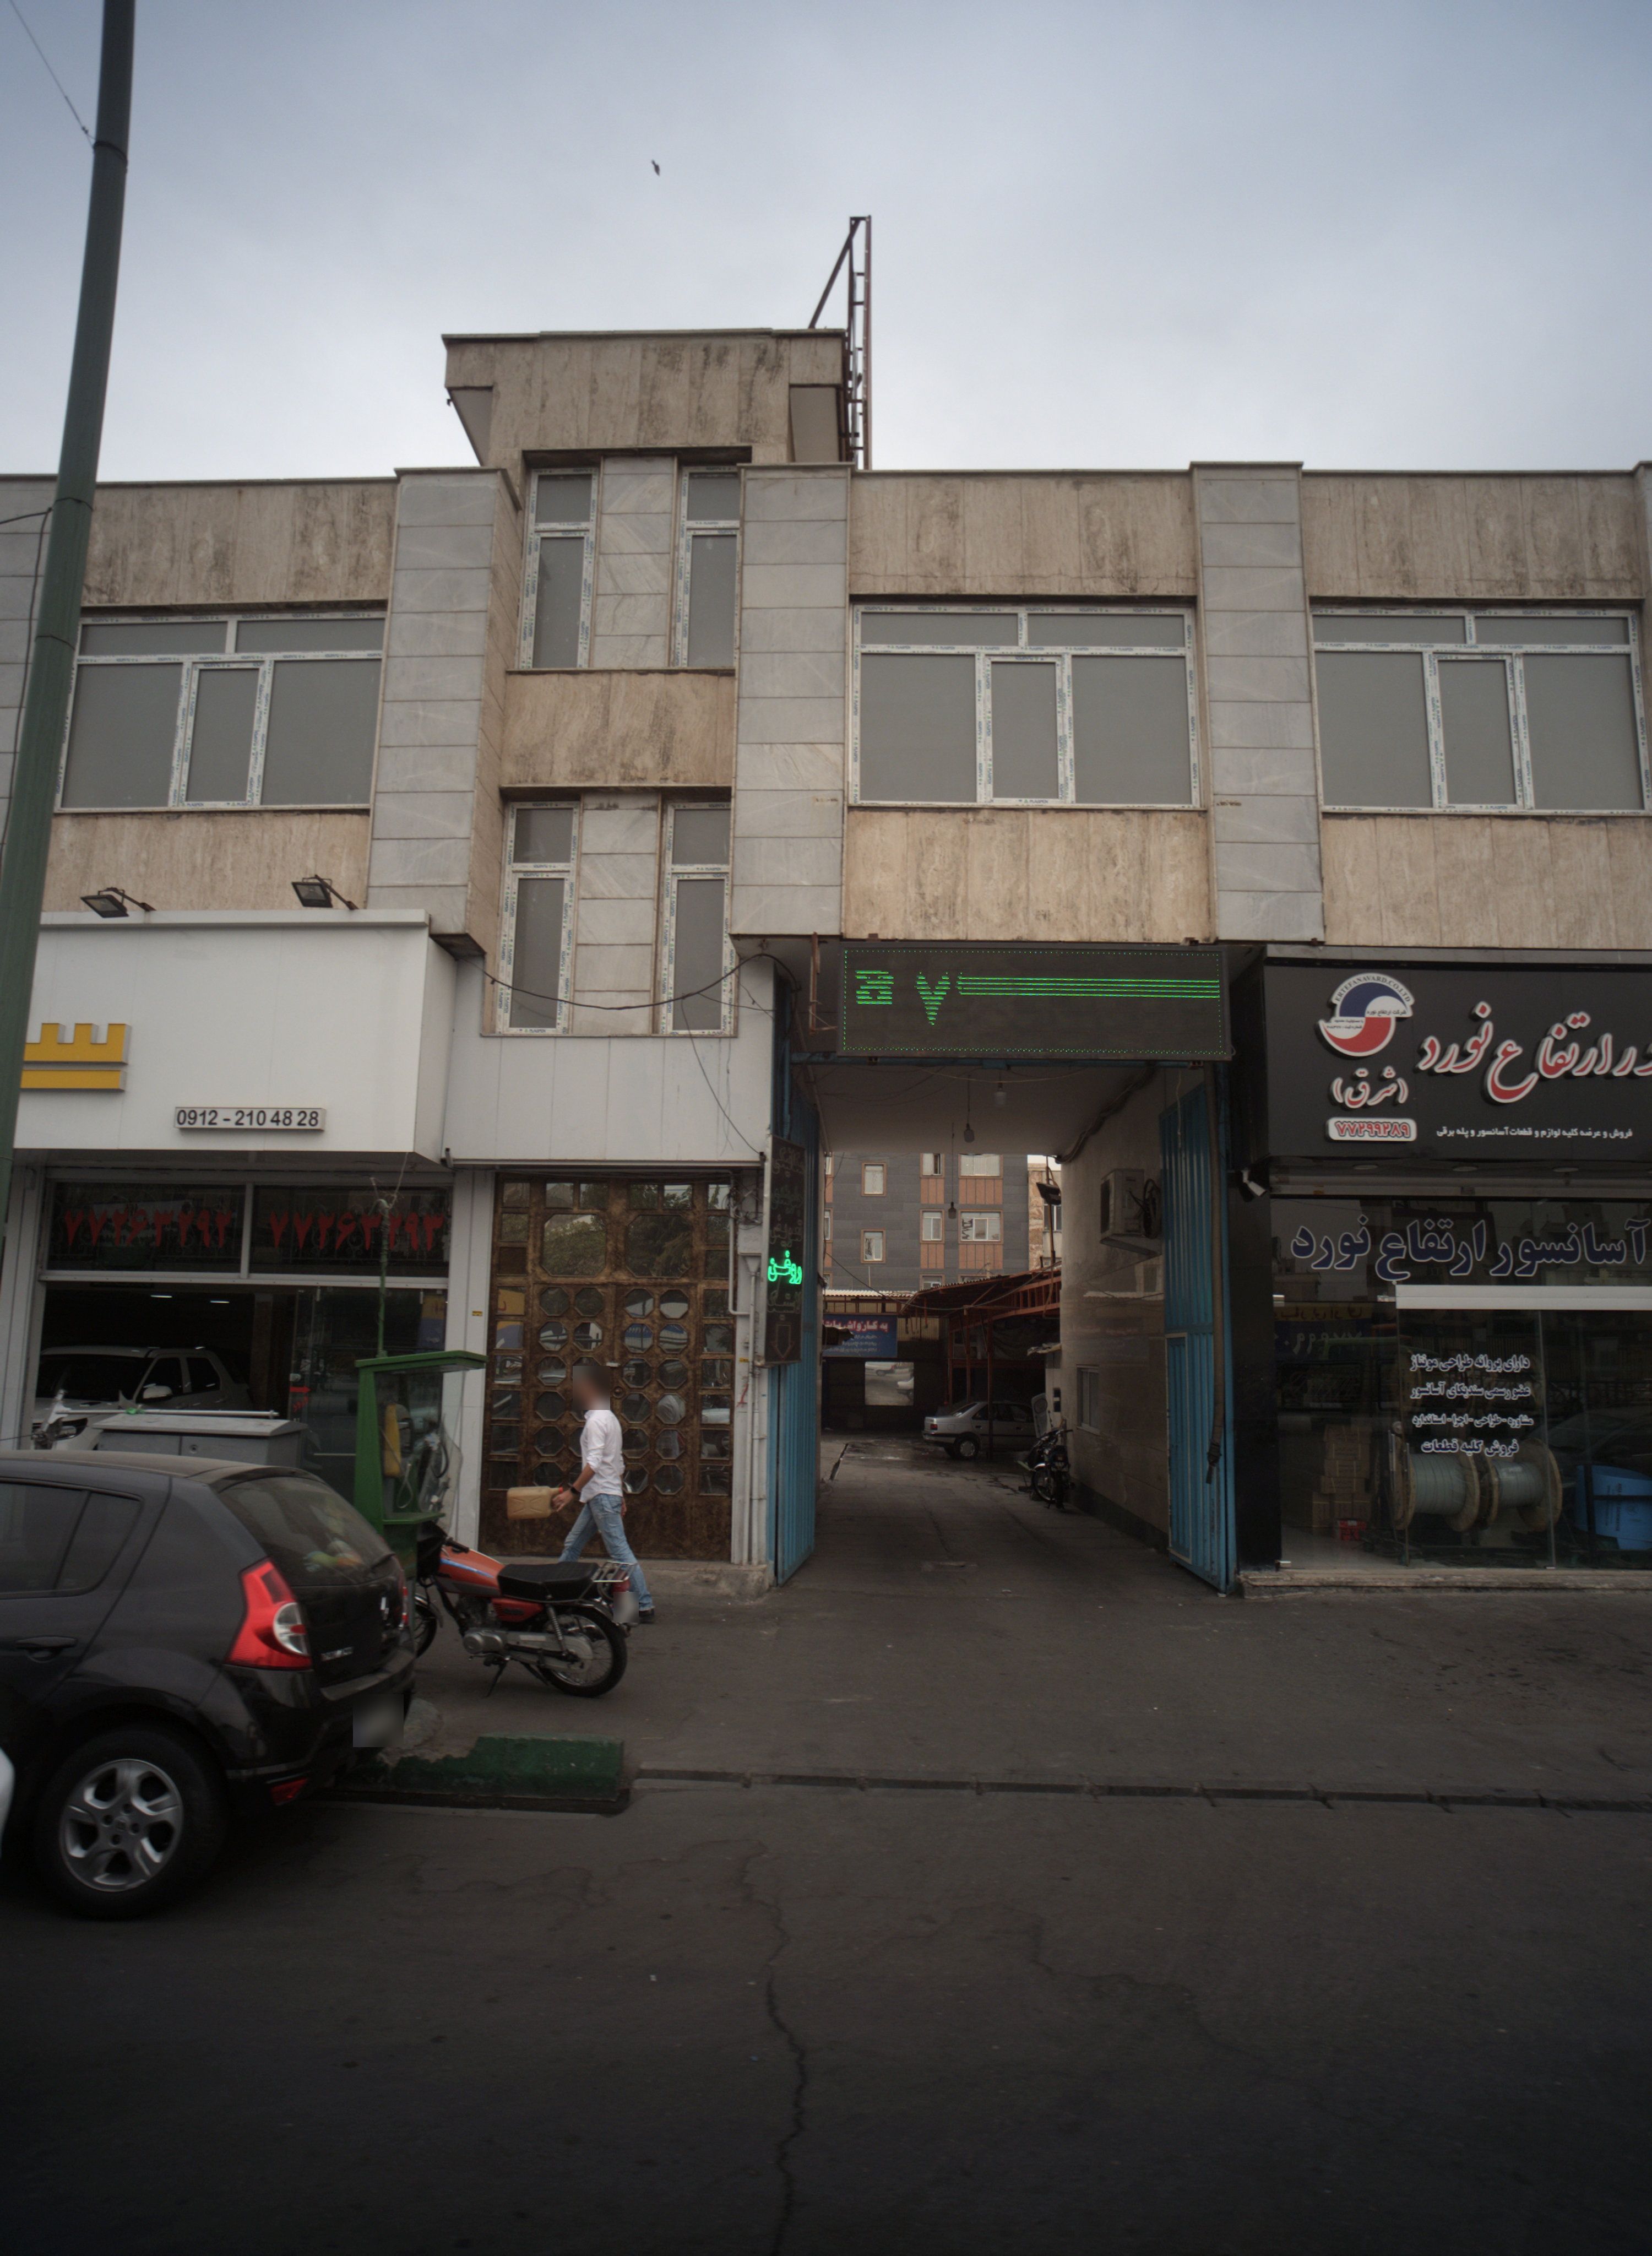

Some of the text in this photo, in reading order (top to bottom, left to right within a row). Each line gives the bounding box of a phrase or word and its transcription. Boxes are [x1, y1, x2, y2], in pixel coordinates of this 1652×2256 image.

[1417, 1001, 1493, 1073] نورد
[1487, 1012, 1612, 1103] ارتفاع
[177, 1109, 218, 1126] 0912
[235, 1110, 267, 1126] 210
[1335, 1121, 1411, 1138] ۷۷۲۹۹۲۸۹
[1436, 1126, 1455, 1137] برقی
[1456, 1128, 1469, 1138] پله
[1476, 1126, 1509, 1137] آسانسور
[1510, 1127, 1533, 1136] قطعات
[1540, 1127, 1561, 1138] لوازم
[1562, 1127, 1579, 1138] کلیه
[1580, 1128, 1601, 1138] عرضه
[1608, 1129, 1633, 1139] فروش
[1290, 1214, 1651, 1282] آسانسور ارتفاع نورد
[767, 1250, 802, 1285] روغن
[1438, 1353, 1474, 1372] طراحی
[1474, 1354, 1503, 1373] پروانه
[1503, 1354, 1531, 1373] دارای
[1409, 1380, 1531, 1400] عضو رسمی سندیکای آسانسور
[1450, 1413, 1469, 1428] اجرا
[1473, 1413, 1502, 1428] طراحی
[1507, 1414, 1535, 1428] مشاوره
[1420, 1438, 1520, 1457] فروش کلیه قطعات
